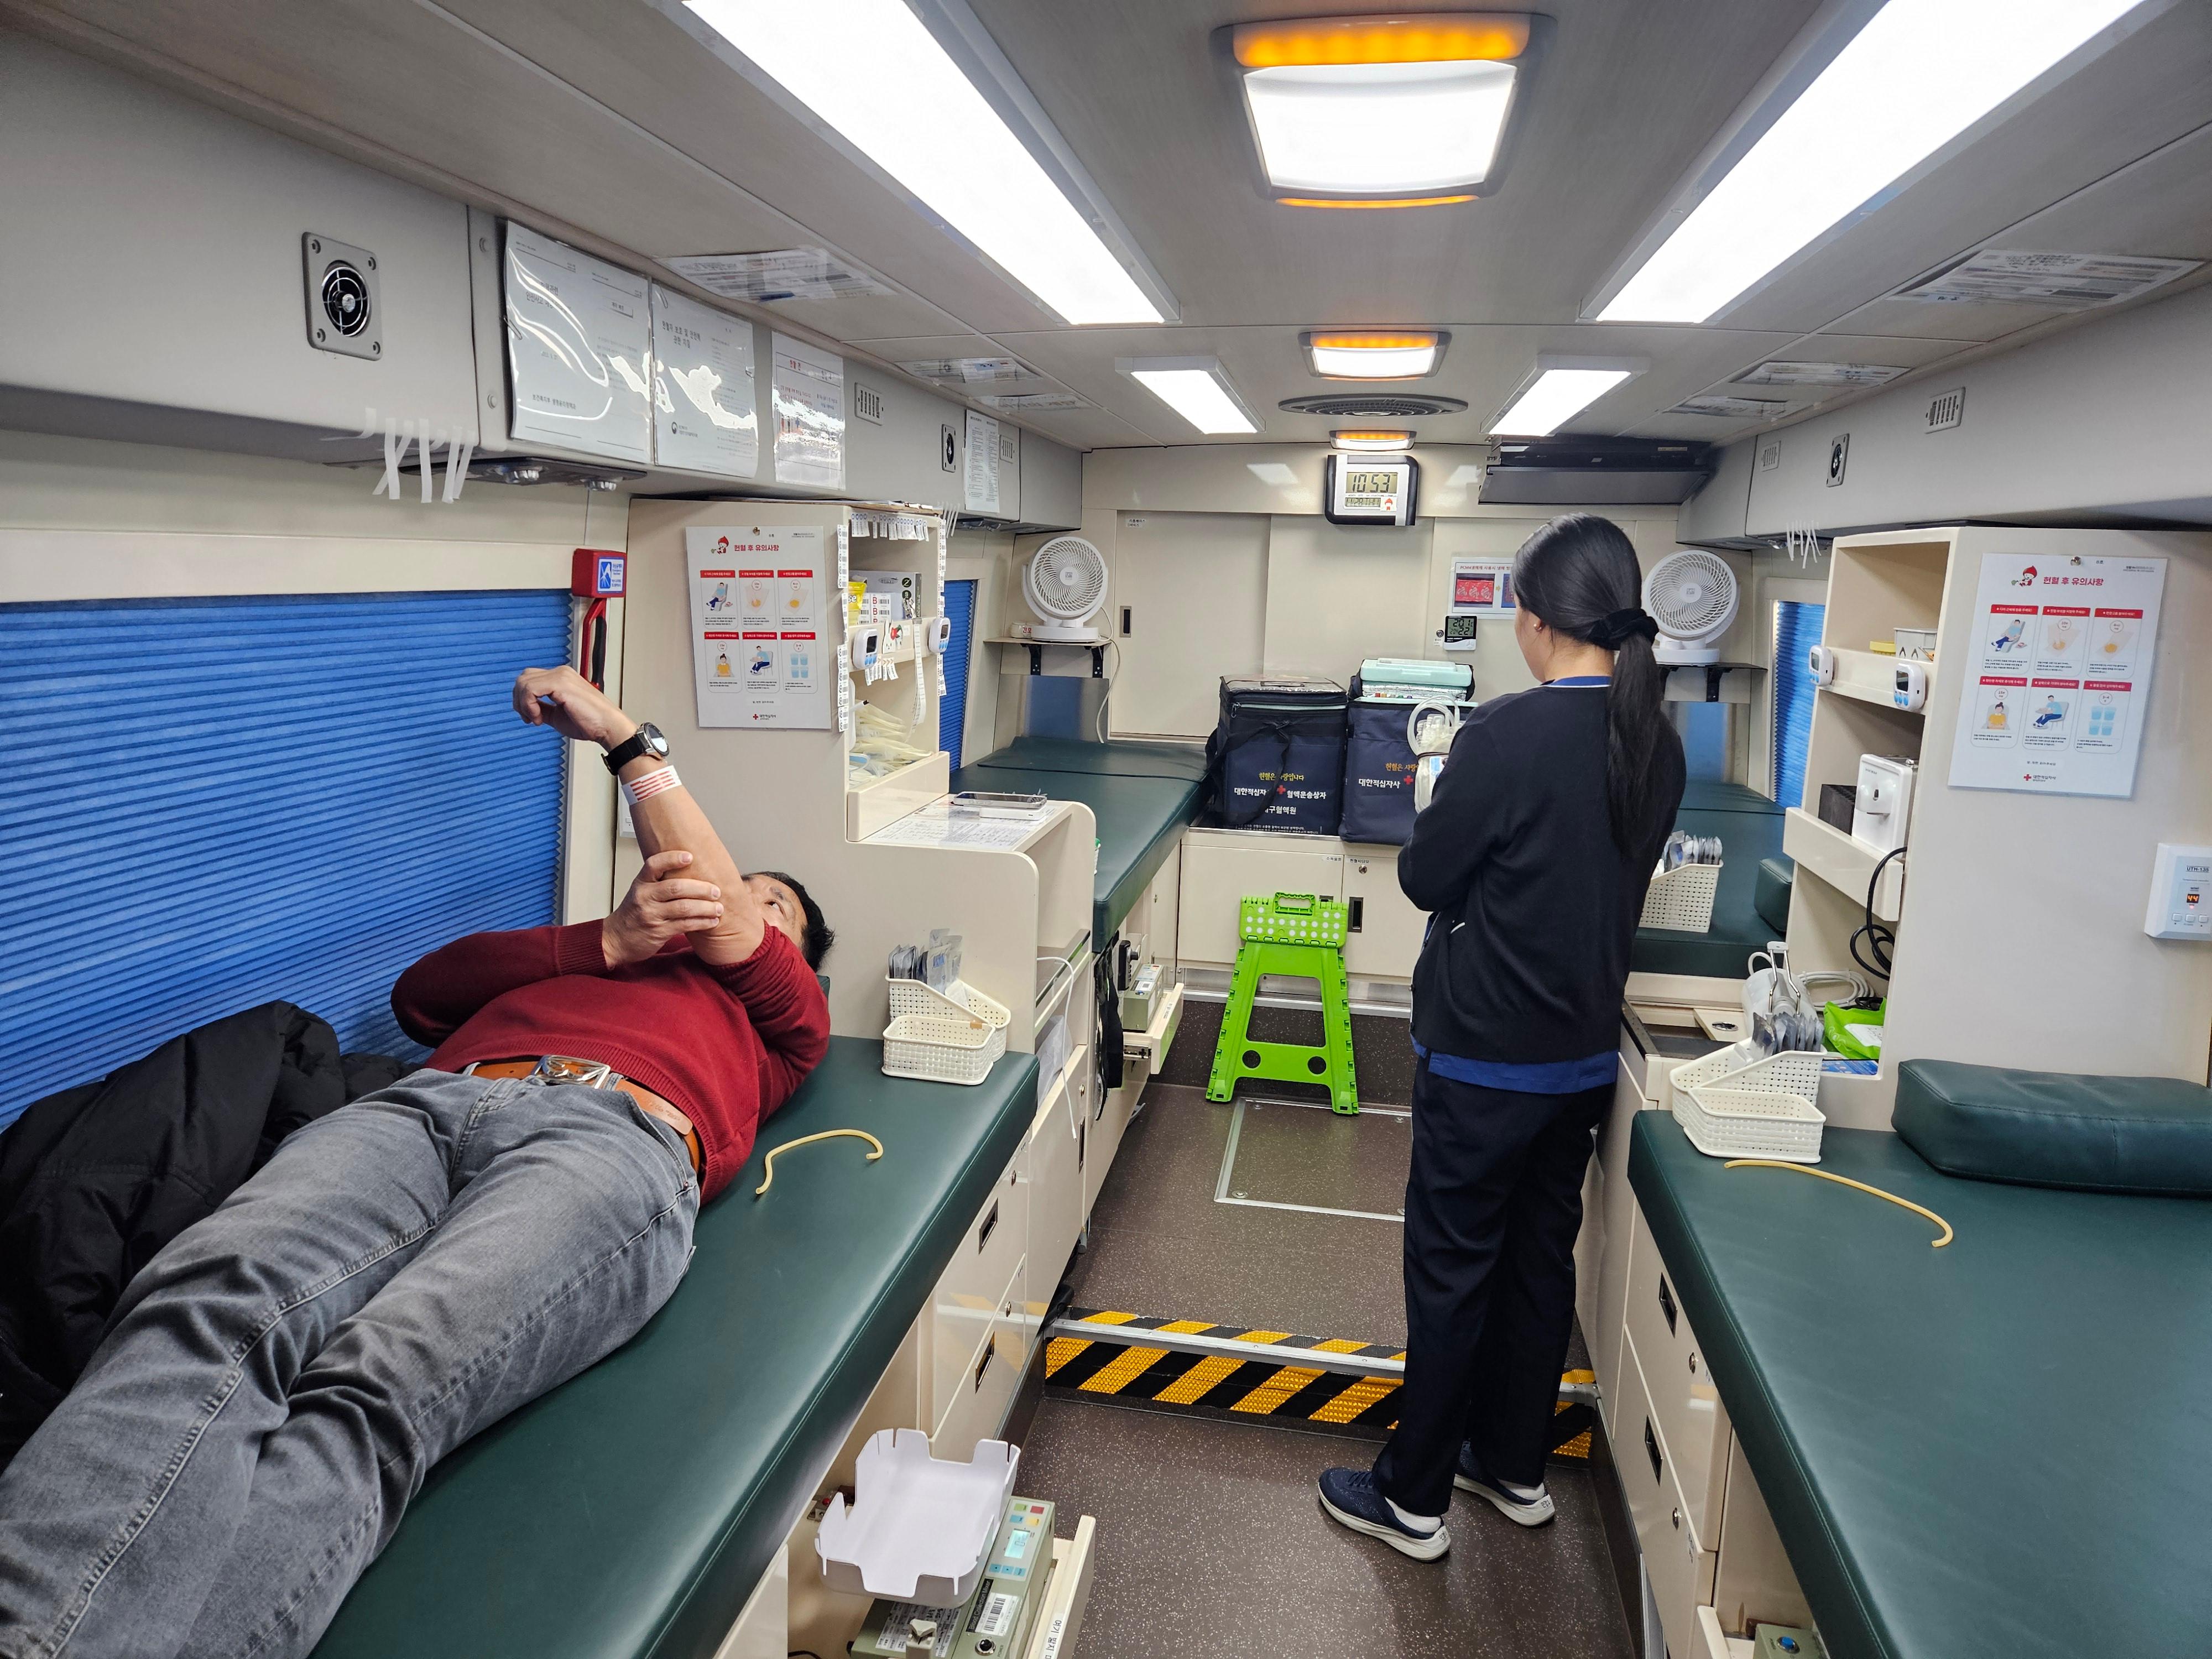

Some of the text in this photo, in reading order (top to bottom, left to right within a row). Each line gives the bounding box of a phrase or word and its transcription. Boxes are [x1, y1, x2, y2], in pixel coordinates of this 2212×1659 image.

[2062, 577, 2069, 585] 후
[2072, 578, 2104, 586] 유의사항
[1385, 763, 1403, 771] 헌혈은
[1259, 772, 1275, 780] 헌혈은
[1358, 778, 1401, 789] 대한적십자사
[1234, 787, 1327, 800] 대한적십자 혈액운송상자
[1051, 1620, 1062, 1634] 여기
